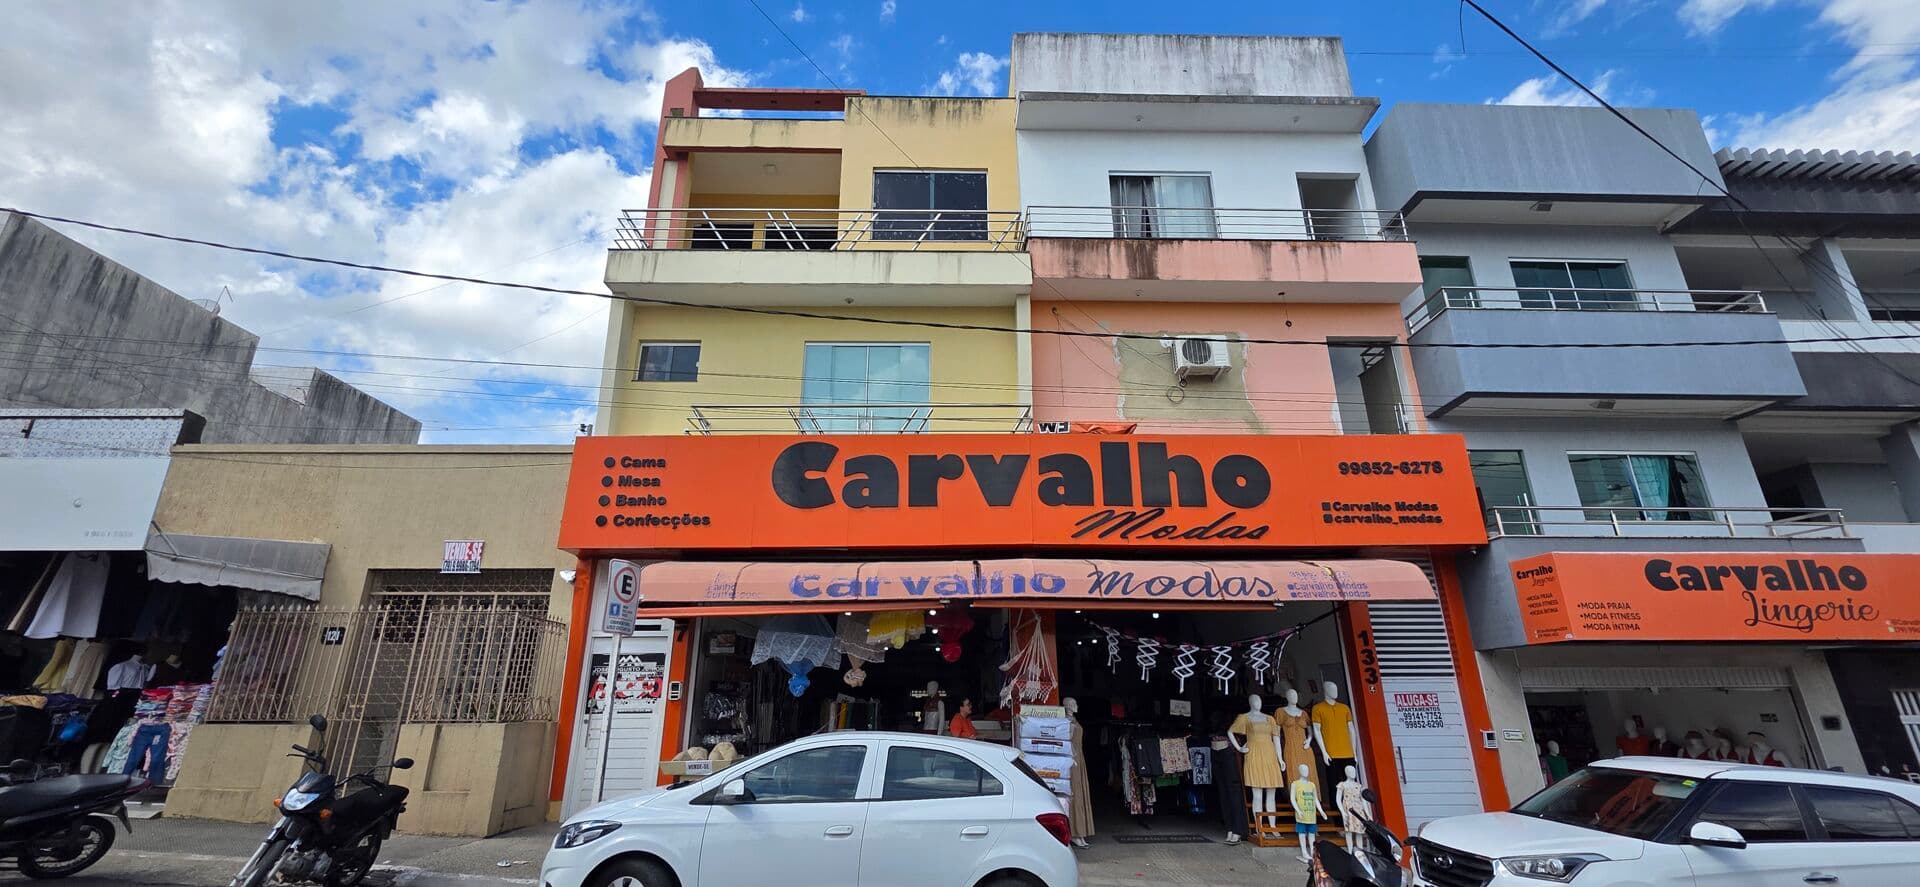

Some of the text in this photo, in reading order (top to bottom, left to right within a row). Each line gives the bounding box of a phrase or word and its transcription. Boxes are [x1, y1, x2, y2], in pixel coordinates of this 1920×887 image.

[620, 456, 666, 468] Cama
[1338, 461, 1443, 475] 99852-6278
[618, 475, 661, 487] Mesa
[771, 440, 1272, 509] Carvalho
[615, 494, 667, 507] Banho
[1332, 501, 1439, 512] Carvalho Modas
[613, 513, 711, 529] Confecções
[1071, 507, 1270, 539] Modas
[1334, 513, 1443, 525] carvalho_modas
[444, 542, 484, 560] VENDE-SE
[1516, 564, 1553, 580] Carvalho
[1643, 558, 1868, 591] Carvalho
[620, 574, 633, 595] E
[1581, 602, 1606, 610] MODA
[1741, 590, 1880, 633] Lingerie
[1583, 612, 1641, 620] MODA FITNESS
[1586, 623, 1611, 631] MODA
[1358, 630, 1378, 684] 133
[1396, 694, 1439, 706] ALUGA-SE
